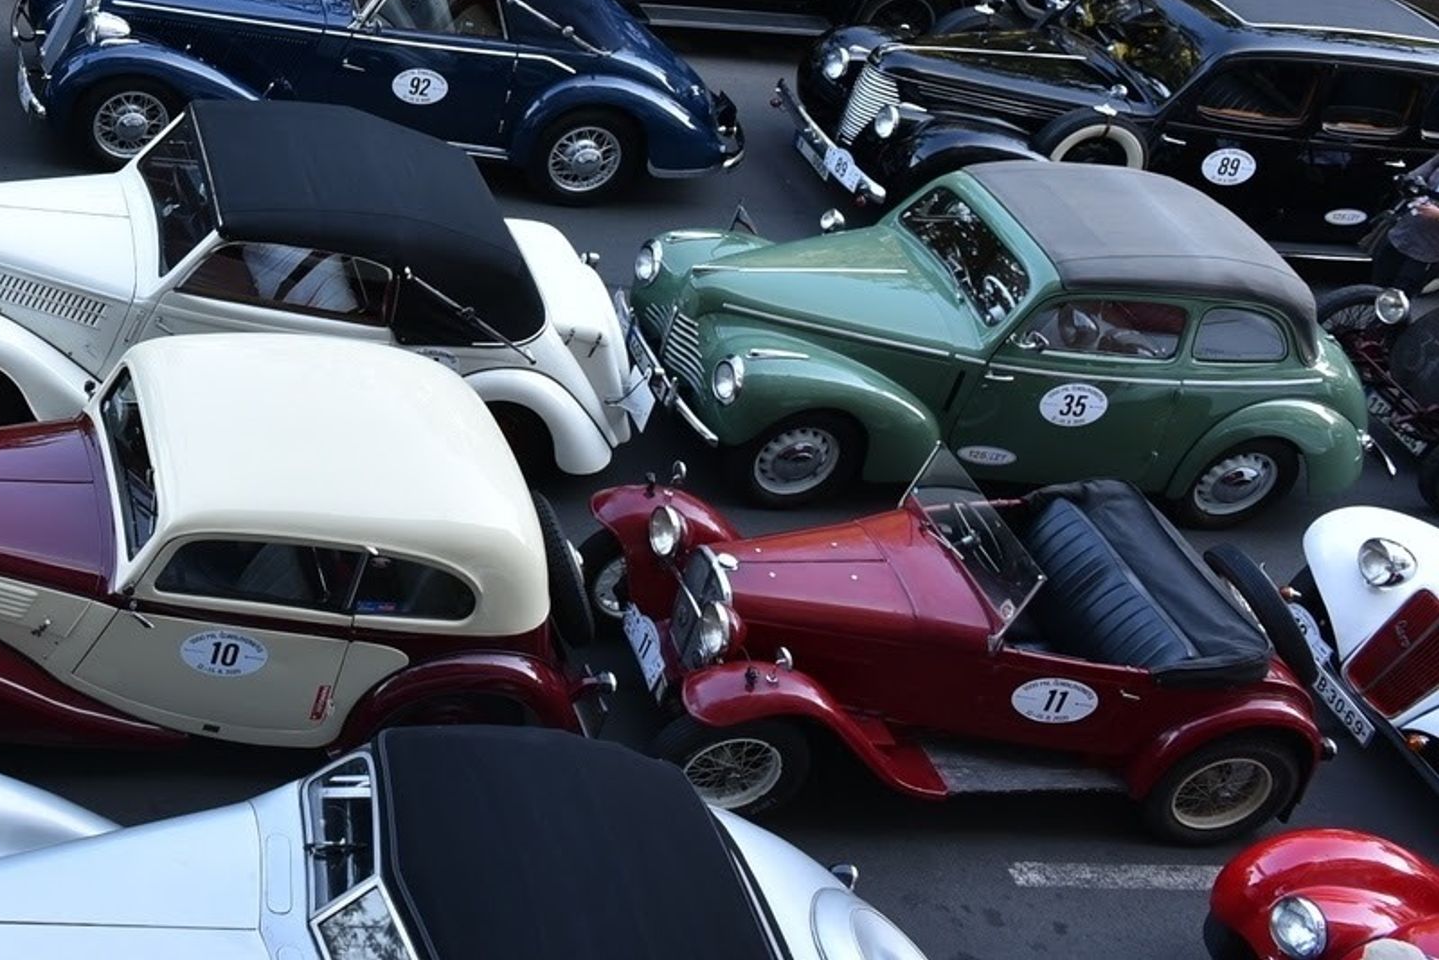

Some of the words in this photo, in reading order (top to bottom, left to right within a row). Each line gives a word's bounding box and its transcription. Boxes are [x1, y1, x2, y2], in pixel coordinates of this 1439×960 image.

[408, 76, 431, 97] 92
[834, 157, 848, 178] 89
[1217, 156, 1241, 177] 89
[1058, 393, 1089, 418] 35
[210, 641, 240, 667] 10
[639, 633, 652, 660] 11
[1042, 689, 1070, 713] 11
